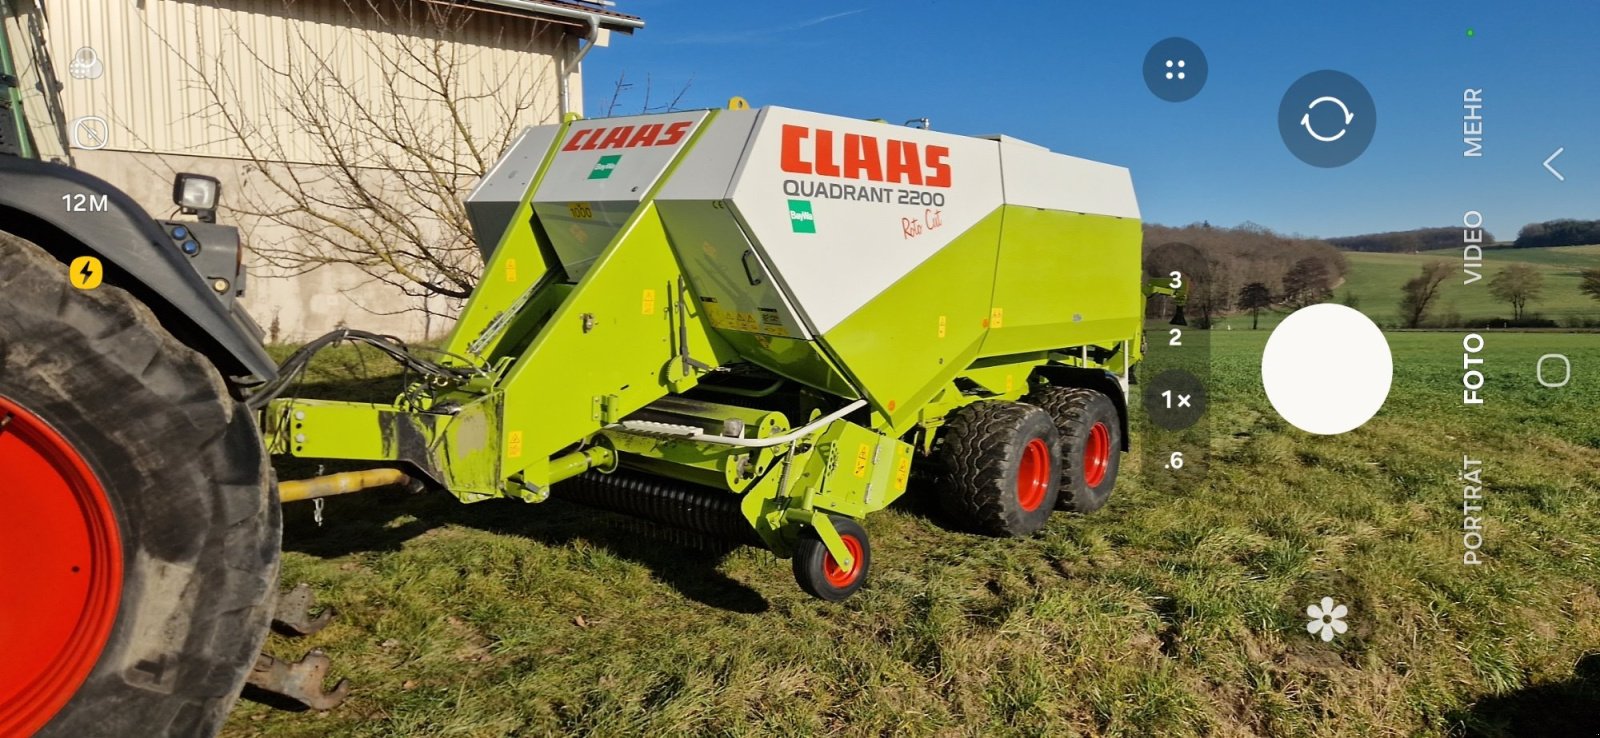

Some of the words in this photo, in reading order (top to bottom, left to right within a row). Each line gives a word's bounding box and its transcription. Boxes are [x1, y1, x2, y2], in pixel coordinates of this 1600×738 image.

[562, 121, 693, 152] CLAAS
[780, 123, 952, 189] CLAAS
[783, 179, 893, 204] QUADRANT
[898, 189, 945, 207] 2200
[569, 207, 592, 218] 1000
[902, 217, 922, 239] Roto
[925, 208, 942, 230] Cut
